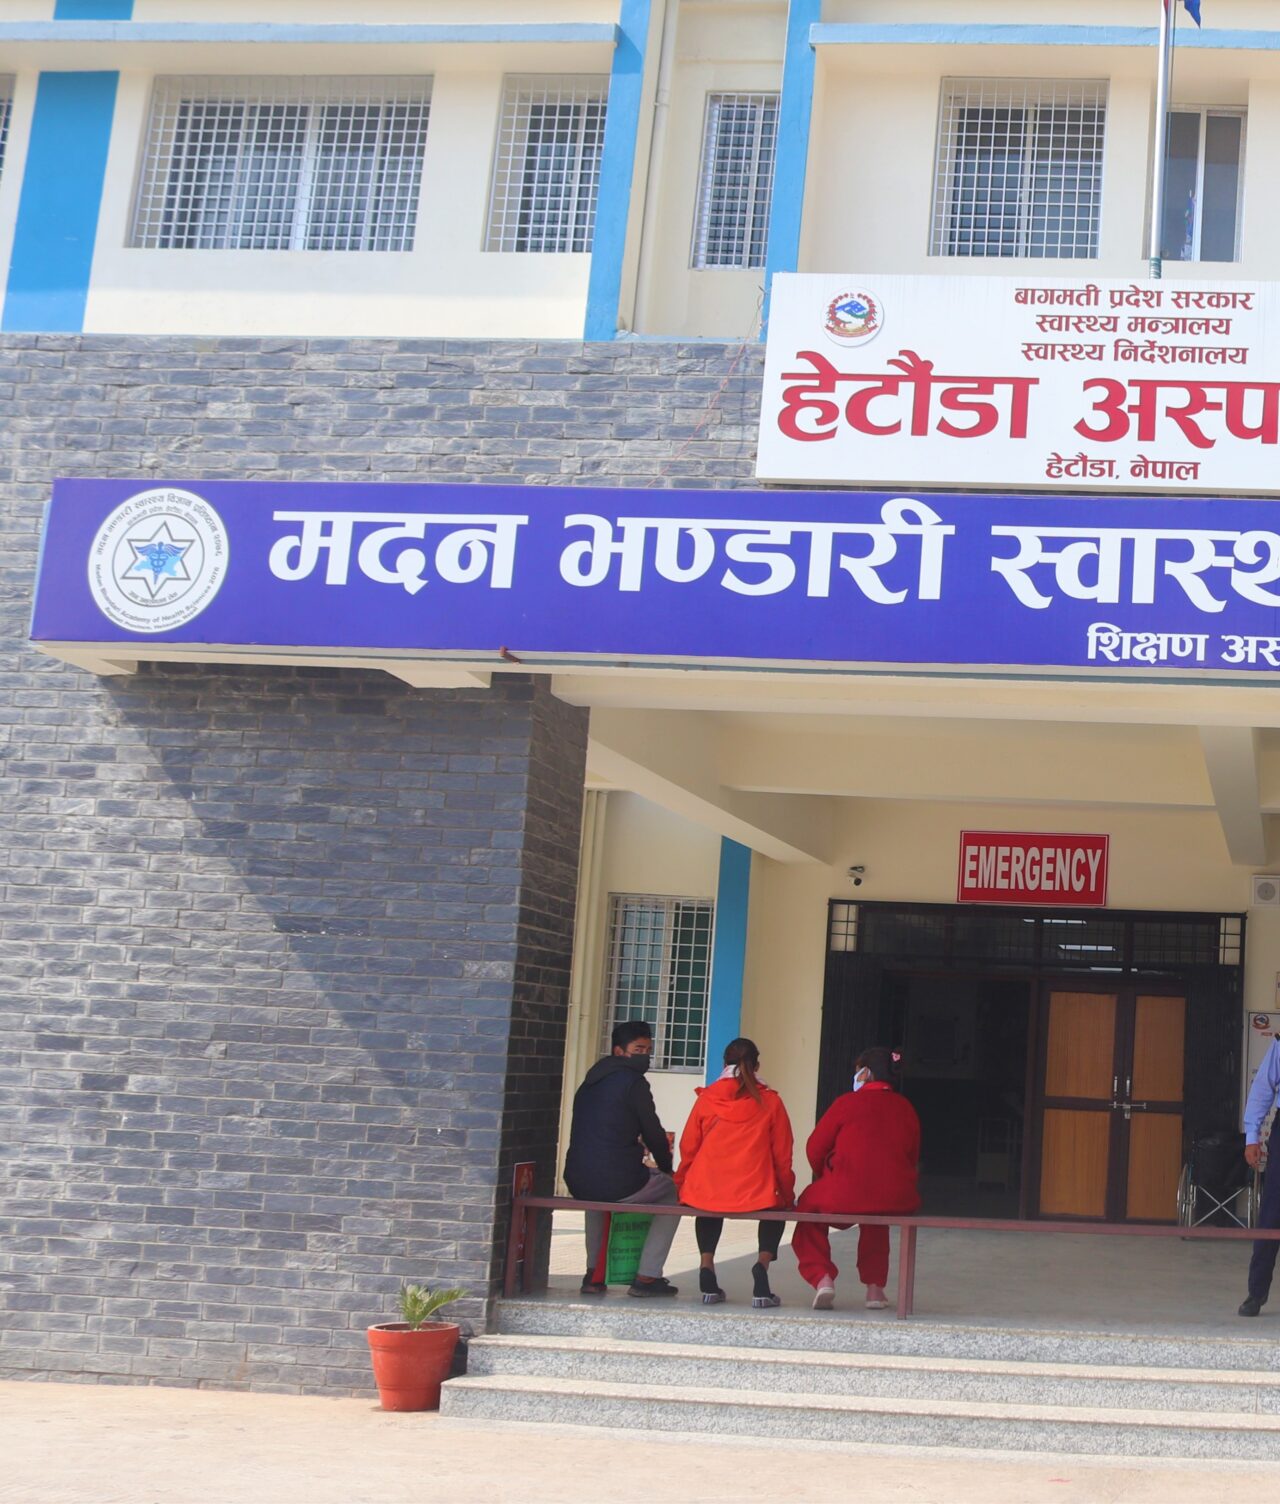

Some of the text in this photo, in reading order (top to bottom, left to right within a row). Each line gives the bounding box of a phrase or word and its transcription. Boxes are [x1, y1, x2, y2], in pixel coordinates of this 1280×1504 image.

[1014, 284, 1255, 310] बागमती प्रदेश सरकार
[1035, 314, 1233, 335] स्वास्थ्य मन्त्रालय
[1021, 339, 1249, 364] स्वास्थ्य निर्देशनालय
[777, 350, 1040, 442] हेटौंडा
[1129, 454, 1201, 481] नेपाल
[267, 510, 528, 596] मदन
[558, 497, 955, 605] भण्डारी
[1087, 622, 1209, 665] शिक्षण
[963, 845, 1103, 892] EMERGENCY
